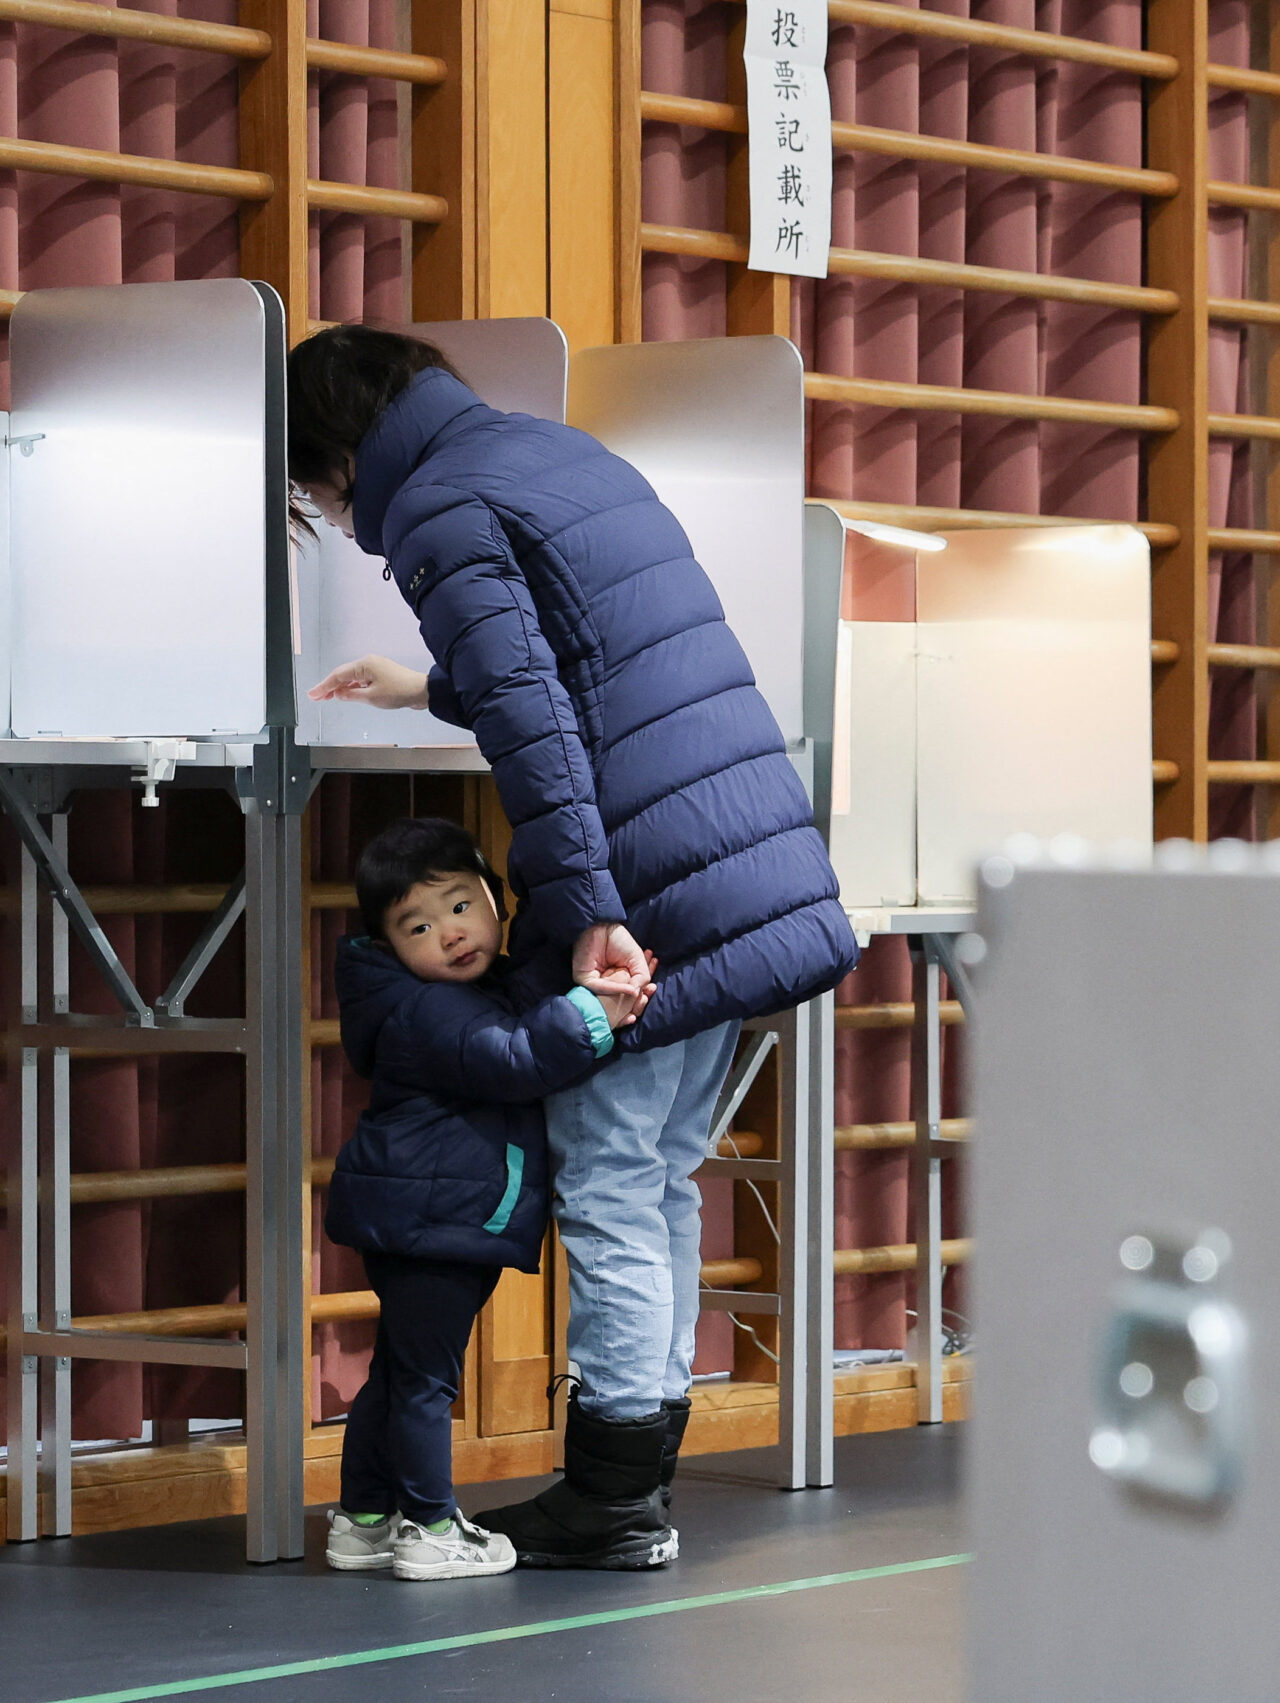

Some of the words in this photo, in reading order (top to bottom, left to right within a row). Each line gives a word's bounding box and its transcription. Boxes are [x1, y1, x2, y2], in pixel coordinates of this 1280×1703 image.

[771, 8, 804, 260] 投票記載所
